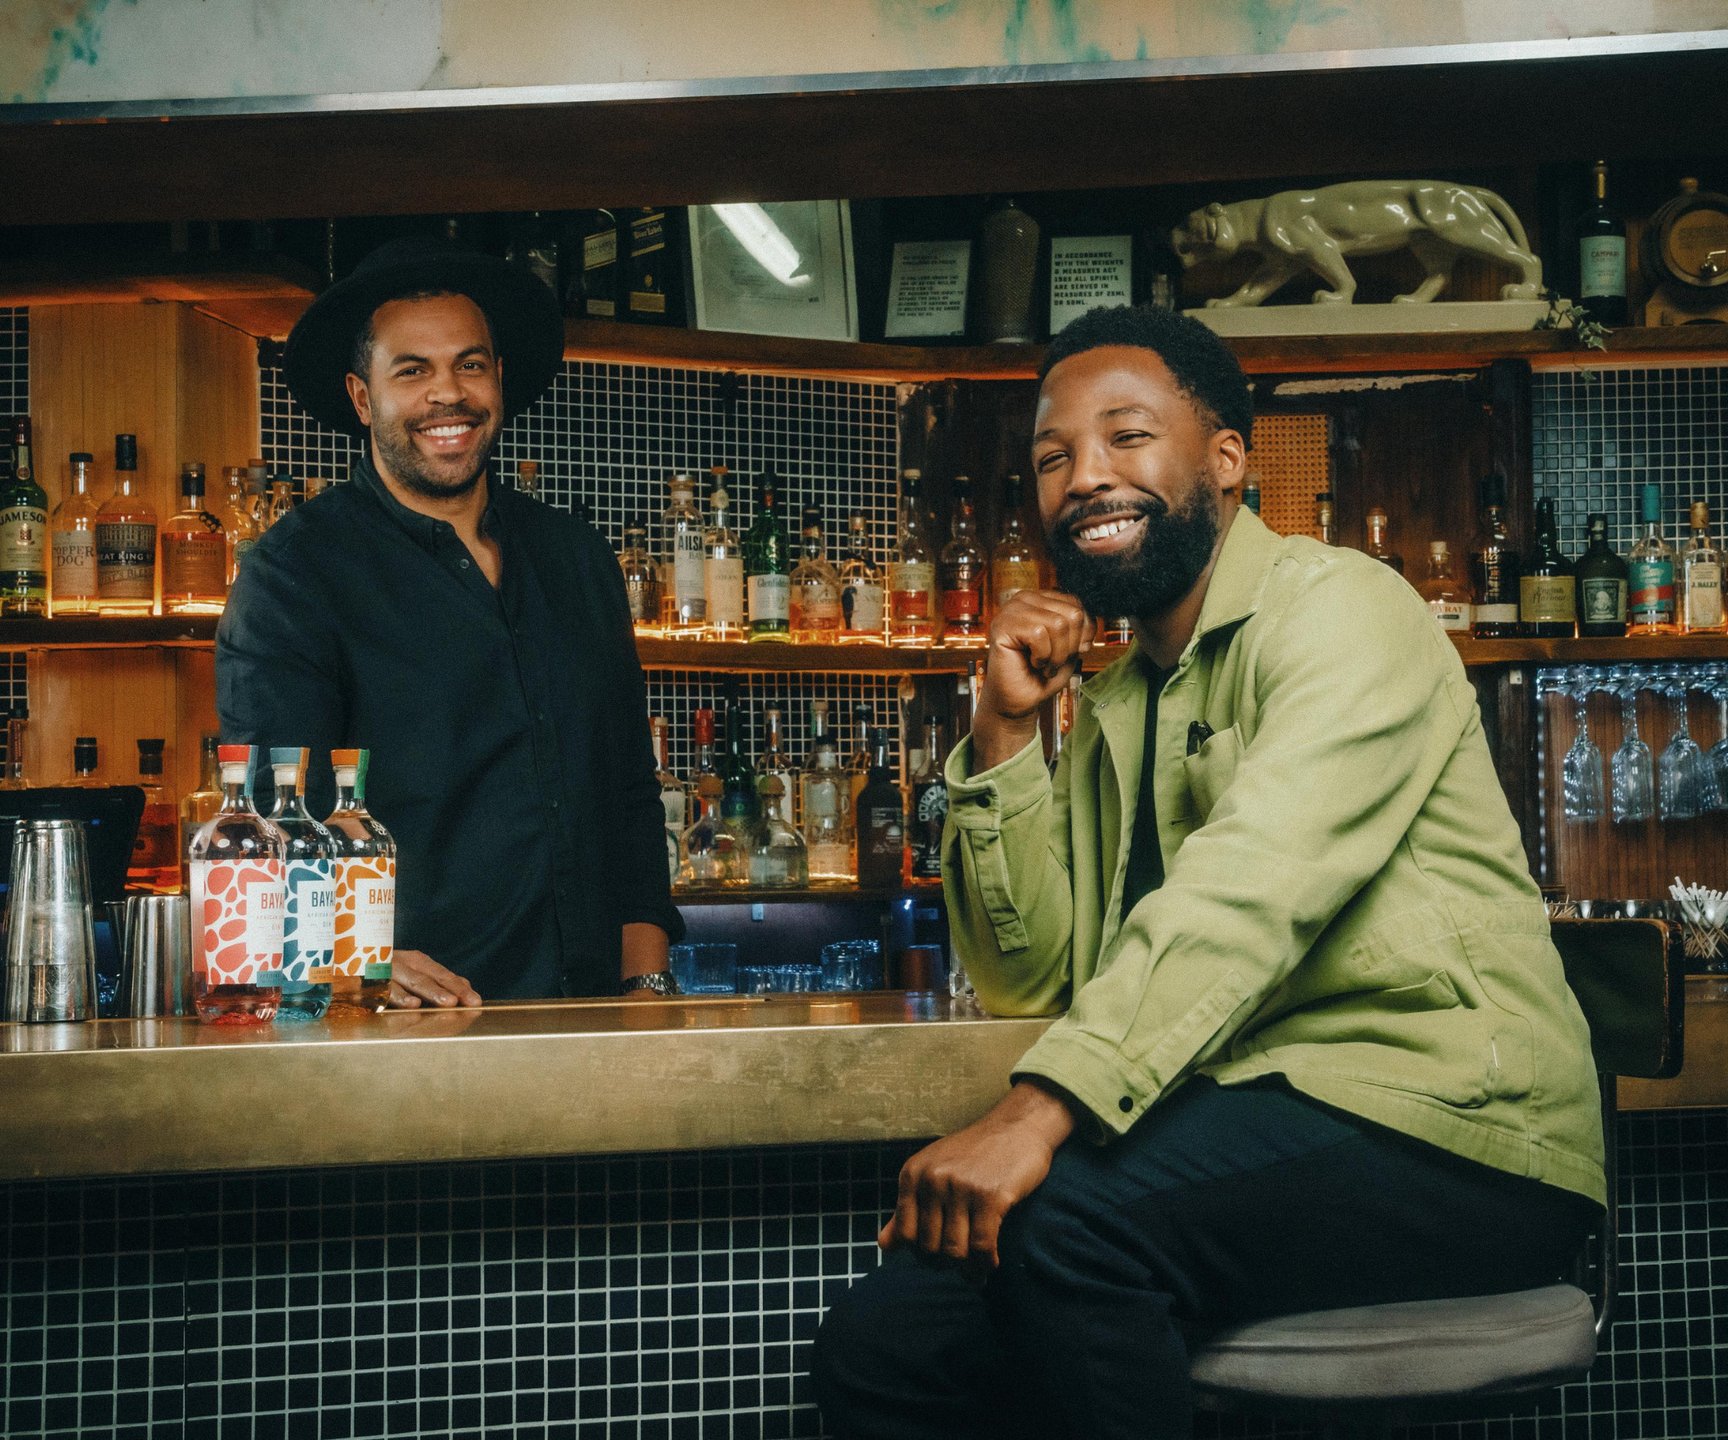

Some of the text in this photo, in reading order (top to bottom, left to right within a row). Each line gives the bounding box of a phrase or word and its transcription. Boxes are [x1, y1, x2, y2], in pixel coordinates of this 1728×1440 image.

[1065, 251, 1112, 259] ACCORDANCE
[57, 554, 84, 568] DOG
[118, 550, 144, 562] KING
